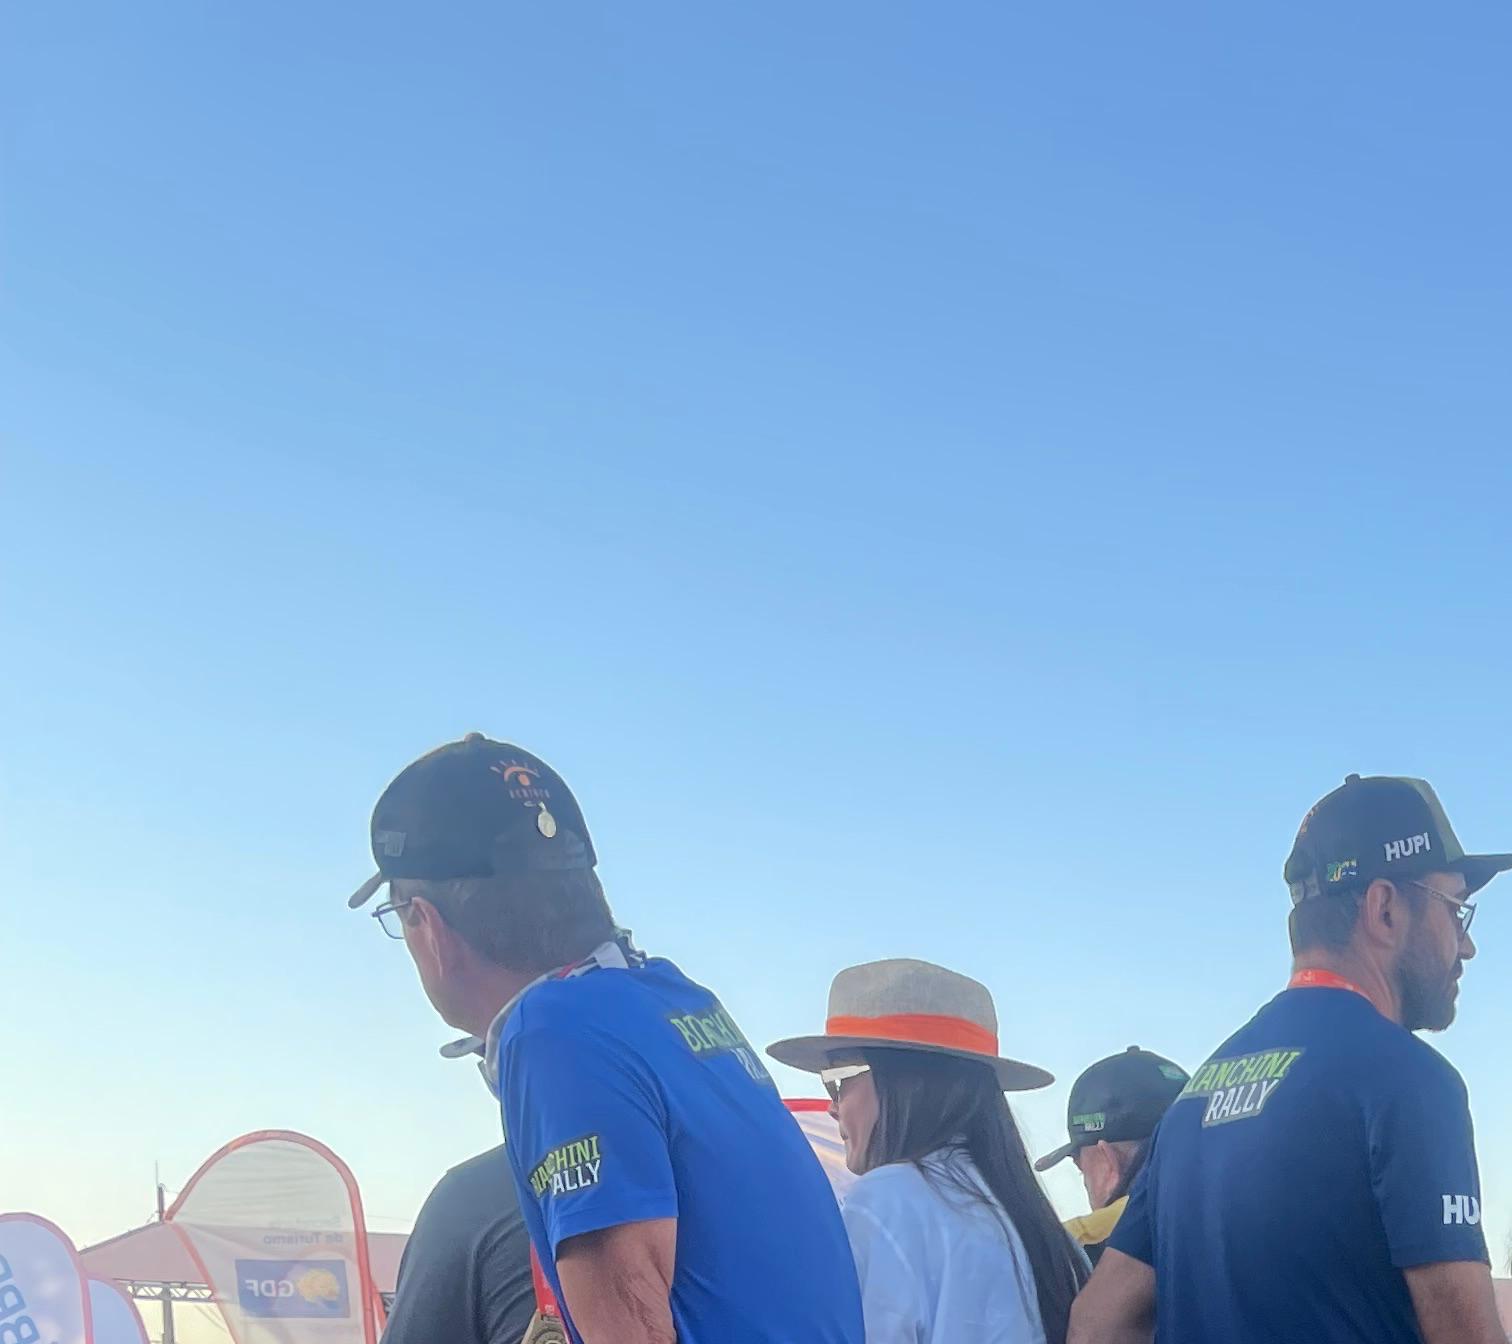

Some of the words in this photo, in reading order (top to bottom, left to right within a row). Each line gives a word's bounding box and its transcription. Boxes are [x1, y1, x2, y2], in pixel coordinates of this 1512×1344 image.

[1384, 832, 1431, 862] HUPI
[1183, 1051, 1301, 1093] IANCHINI
[1204, 1079, 1280, 1122] RALLY
